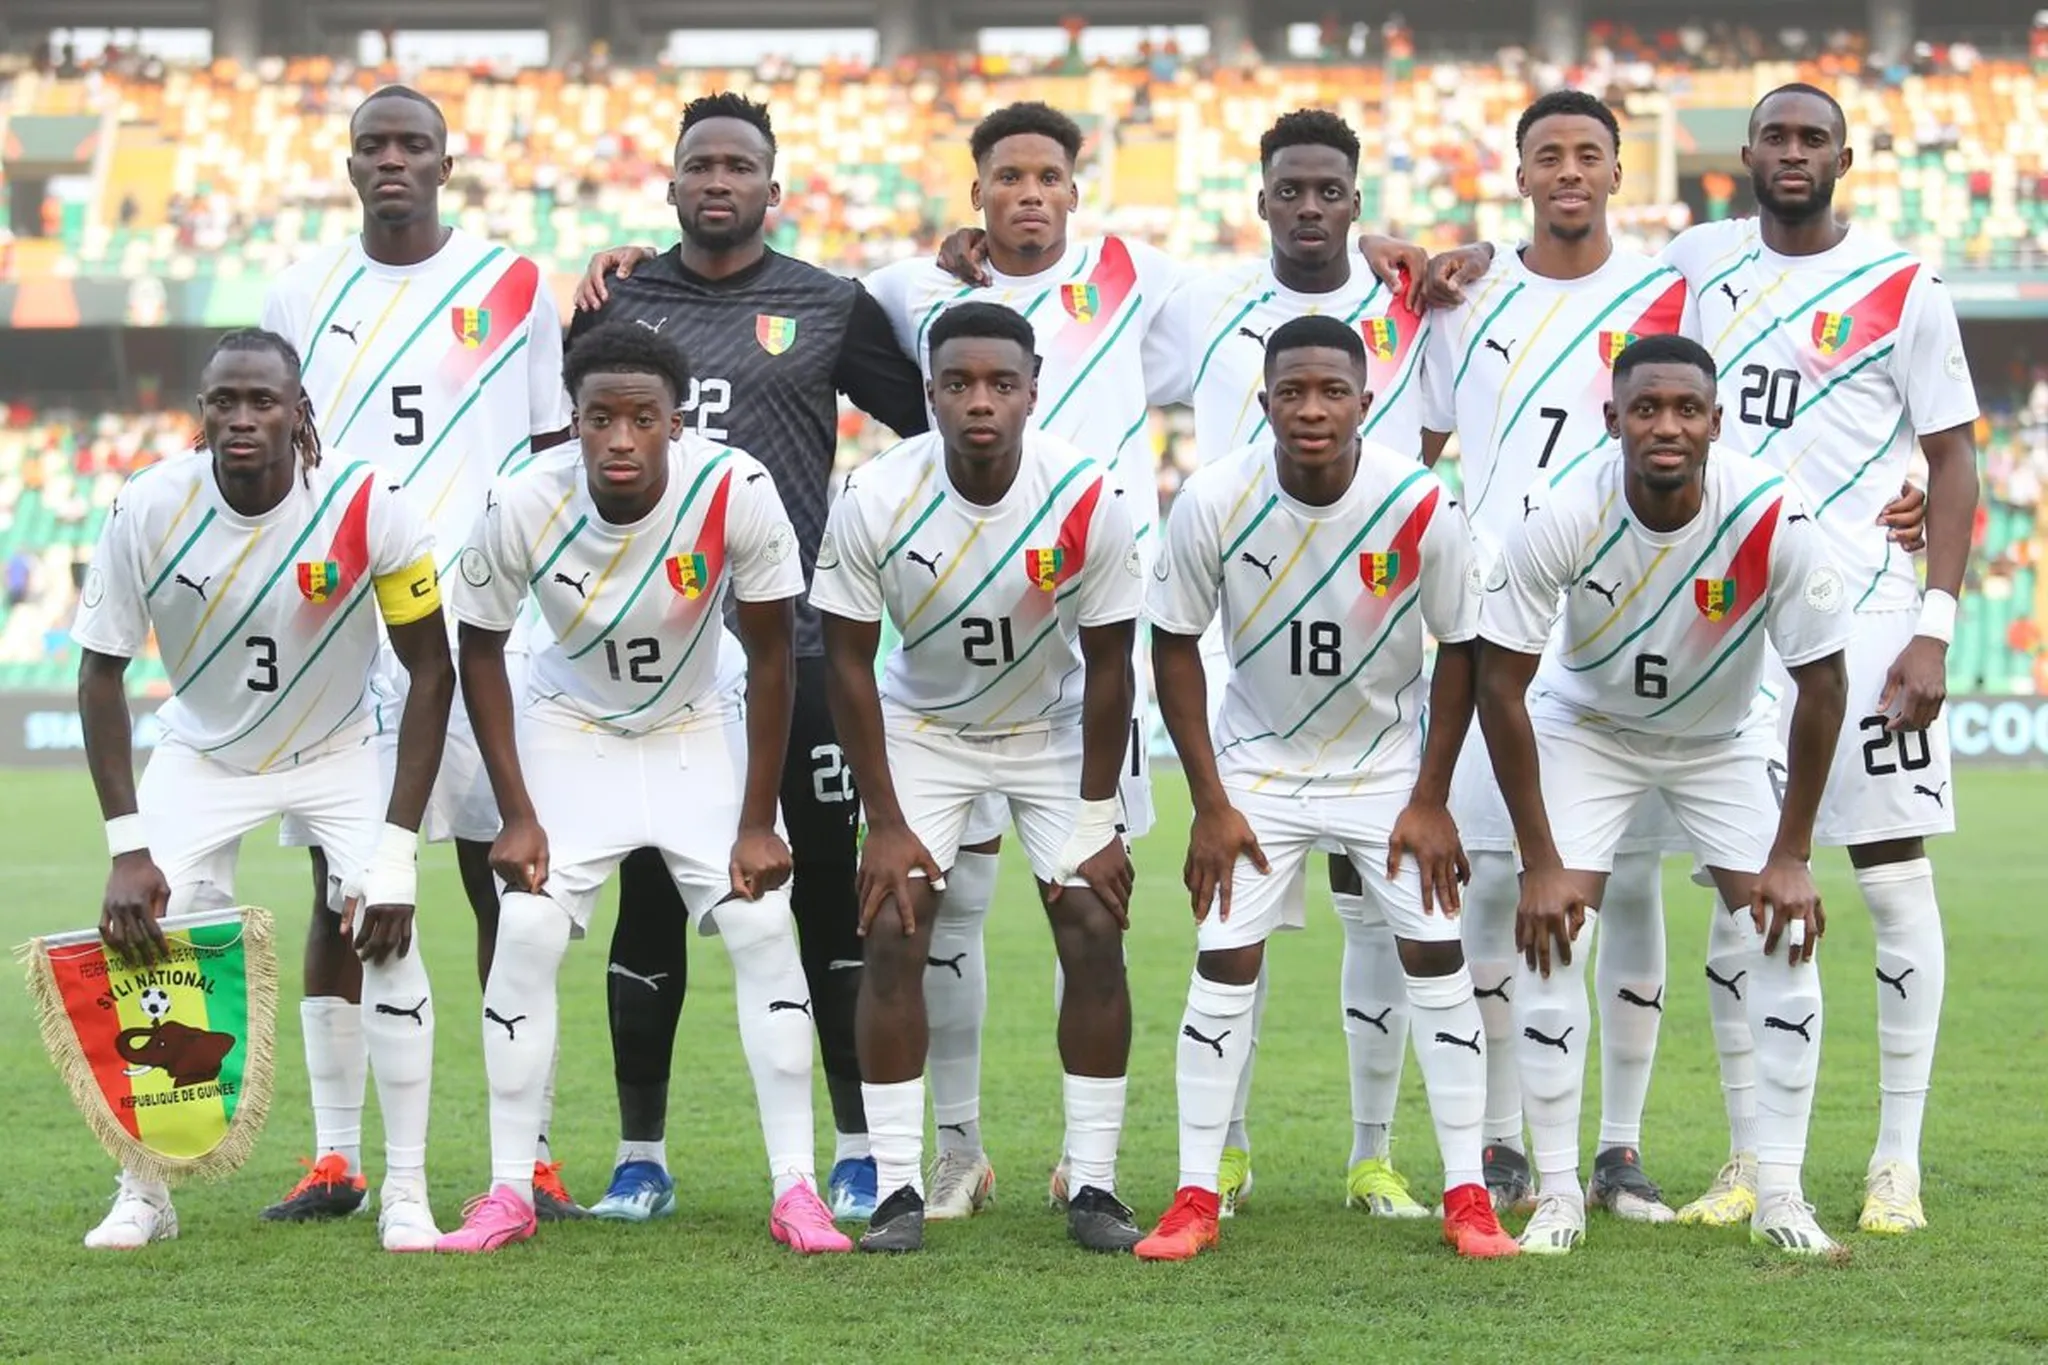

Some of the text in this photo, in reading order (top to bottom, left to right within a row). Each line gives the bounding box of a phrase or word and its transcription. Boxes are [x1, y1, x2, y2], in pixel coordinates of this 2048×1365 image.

[392, 385, 424, 446] 5
[1740, 364, 1801, 429] 20
[1538, 407, 1568, 468] 7
[245, 635, 279, 693] 3
[603, 637, 664, 684] 12
[960, 616, 1014, 667] 21
[1290, 620, 1342, 677] 18
[1634, 652, 1668, 700] 6
[1859, 714, 1932, 776] 20
[96, 970, 216, 1011] SYLI NATIONAL
[181, 1087, 195, 1102] DE
